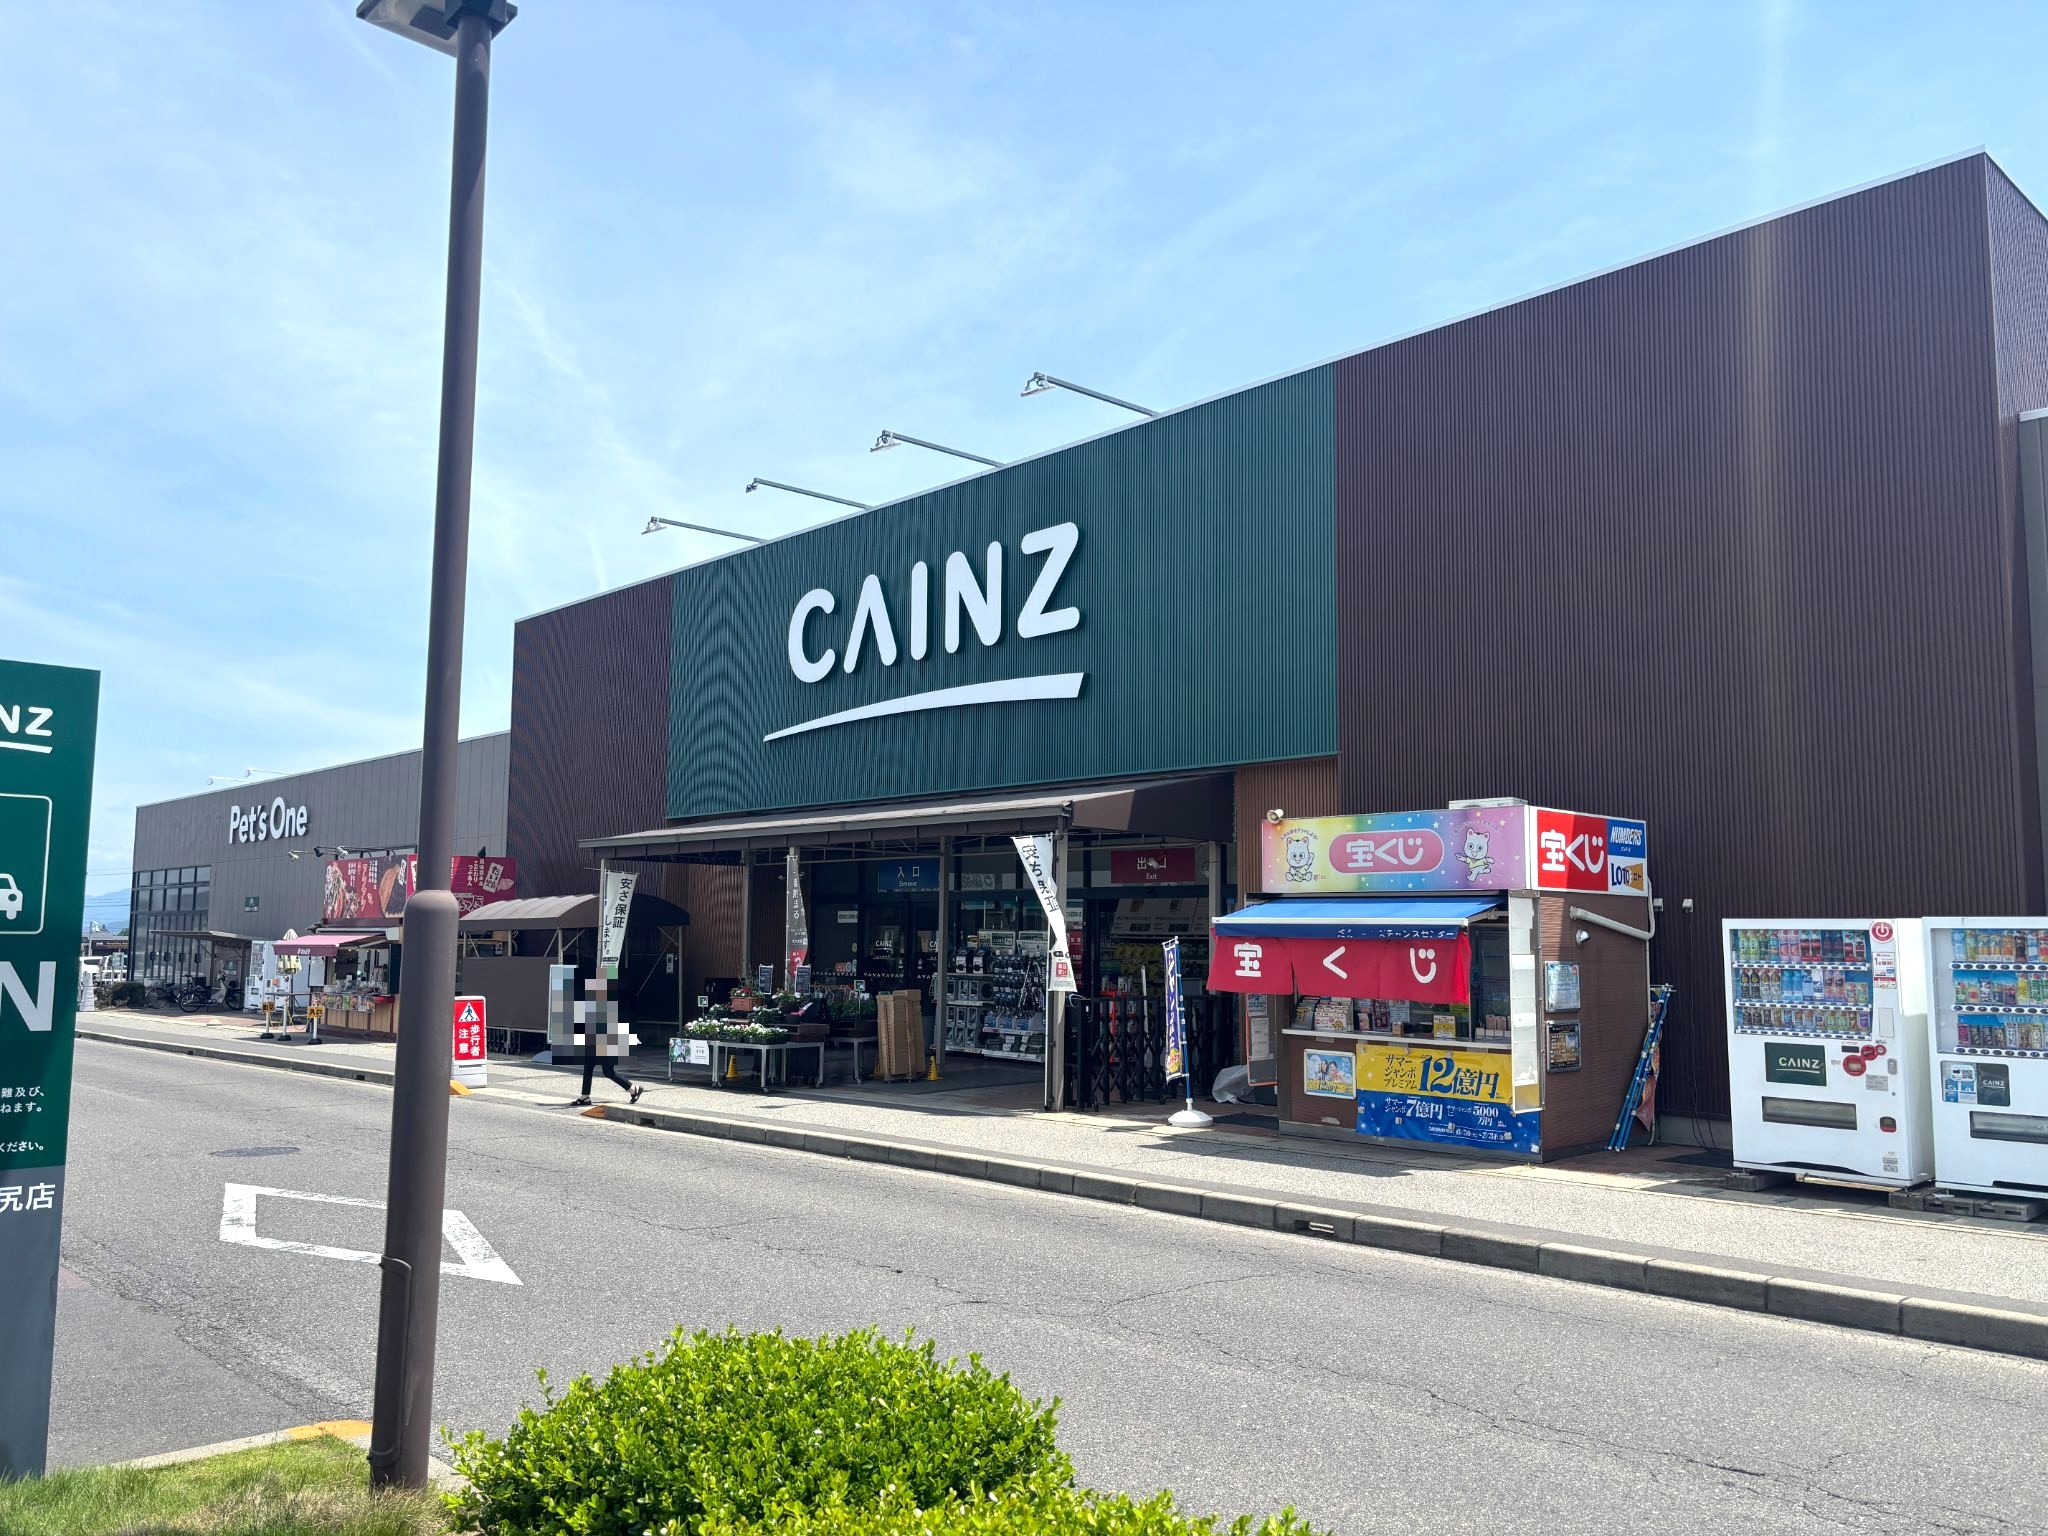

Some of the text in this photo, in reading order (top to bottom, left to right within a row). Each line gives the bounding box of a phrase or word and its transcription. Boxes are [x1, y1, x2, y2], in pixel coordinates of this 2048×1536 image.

[788, 522, 1080, 683] CAINZ
[229, 796, 308, 844] Pet's One
[1610, 826, 1642, 846] NUMBERS
[1346, 838, 1423, 867] 宝くじ
[1541, 829, 1604, 873] 宝くじ
[897, 866, 920, 878] 入口
[1611, 863, 1630, 886] LOTO
[613, 878, 633, 929] 安さ保証
[1233, 942, 1437, 984] 宝くじ
[308, 1008, 323, 1017] 入口
[459, 1028, 469, 1054] 注意
[470, 1024, 480, 1056] 歩行者
[1385, 1054, 1413, 1067] サマー
[1779, 1057, 1820, 1068] CAINZ
[1384, 1067, 1417, 1079] ジャンボ
[1384, 1078, 1418, 1090] プレミアム
[1418, 1055, 1499, 1099] 12億円
[1, 1086, 45, 1098] 難及び、
[0, 1101, 42, 1114] ねます。
[1406, 1098, 1443, 1120] 7億円
[1478, 1117, 1493, 1127] 万円
[0, 1182, 56, 1214] 尻店
